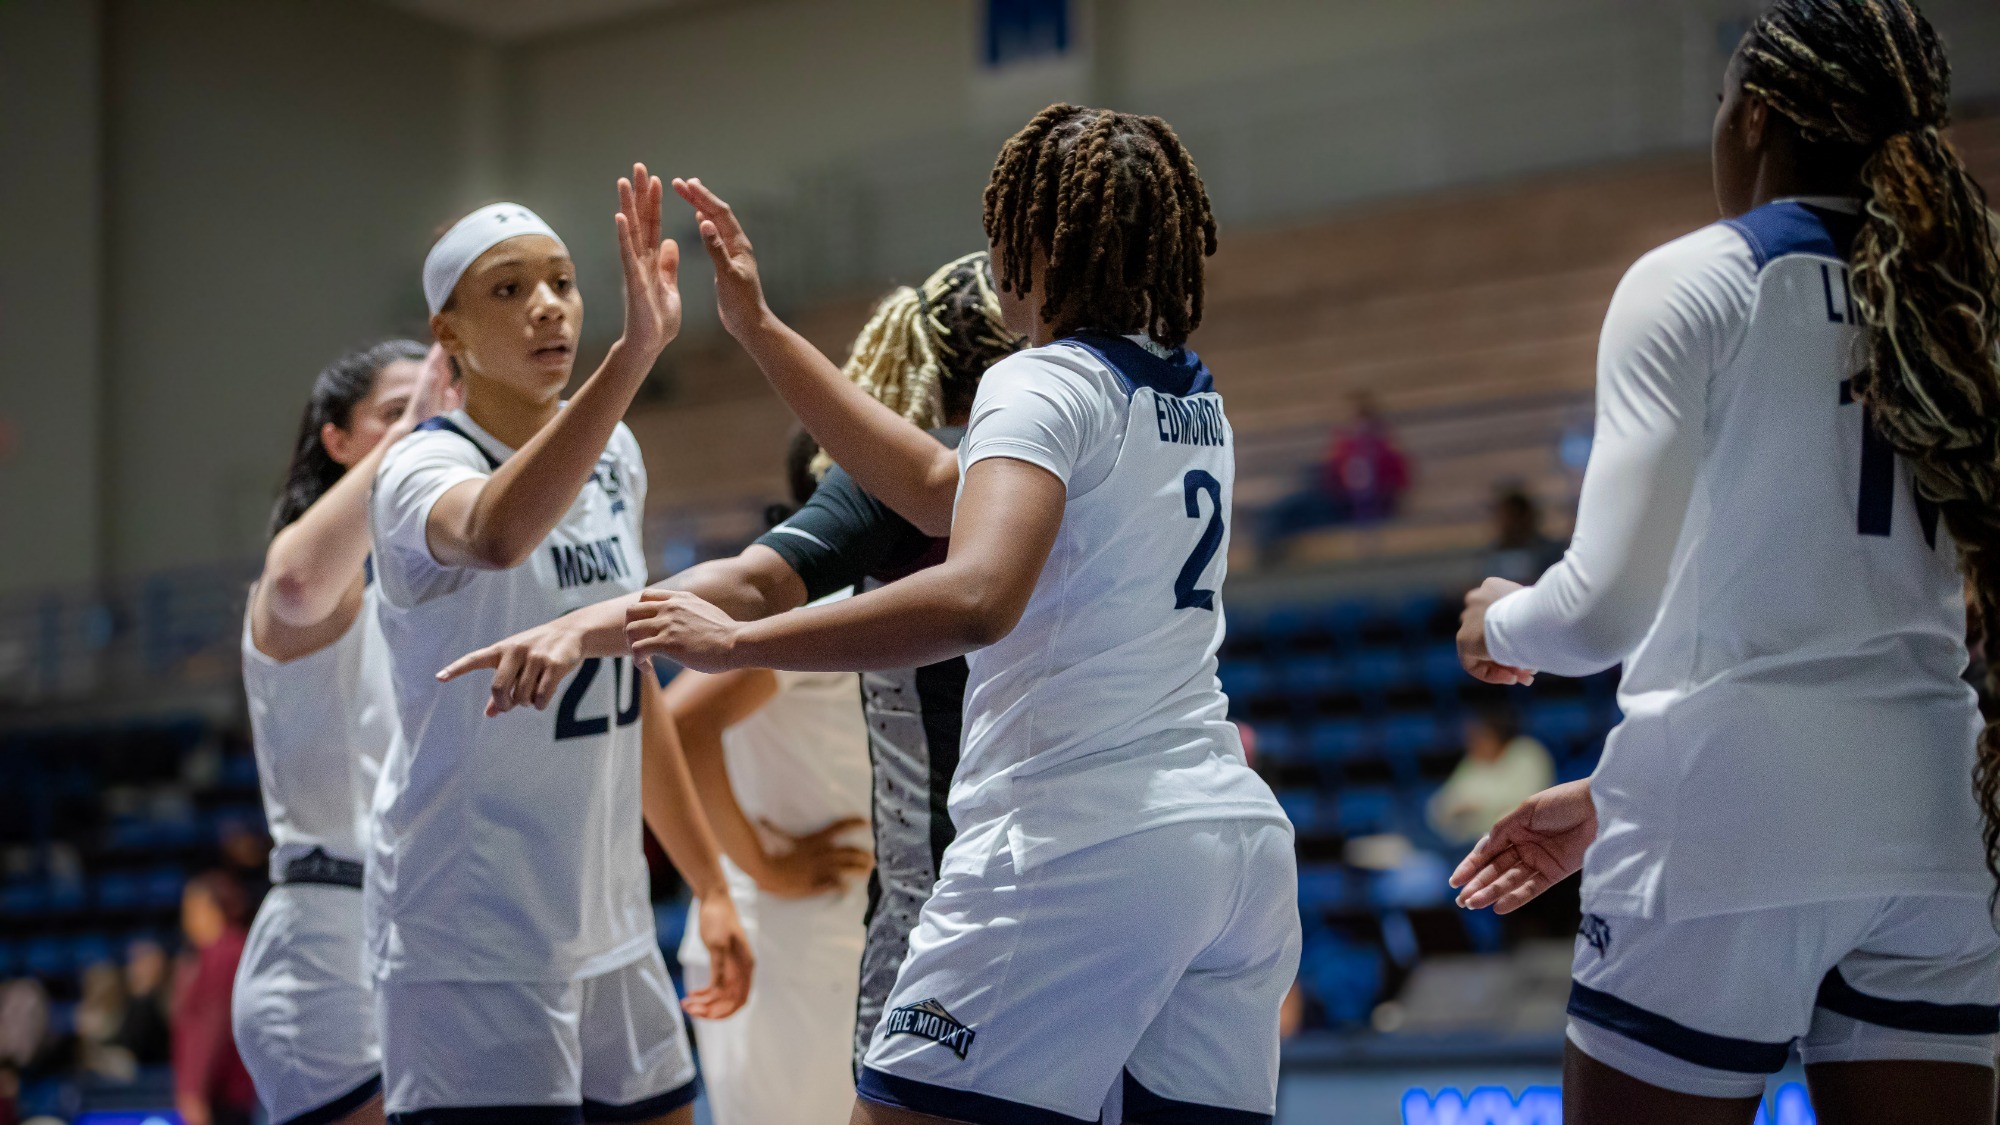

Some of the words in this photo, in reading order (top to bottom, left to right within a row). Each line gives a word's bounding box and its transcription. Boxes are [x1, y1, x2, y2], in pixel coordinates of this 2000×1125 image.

[1153, 391, 1225, 447] EDMONDS
[551, 537, 631, 589] MOUNT
[1174, 469, 1225, 612] 2
[886, 1009, 915, 1037] THE
[913, 1012, 973, 1055] MOUNT
